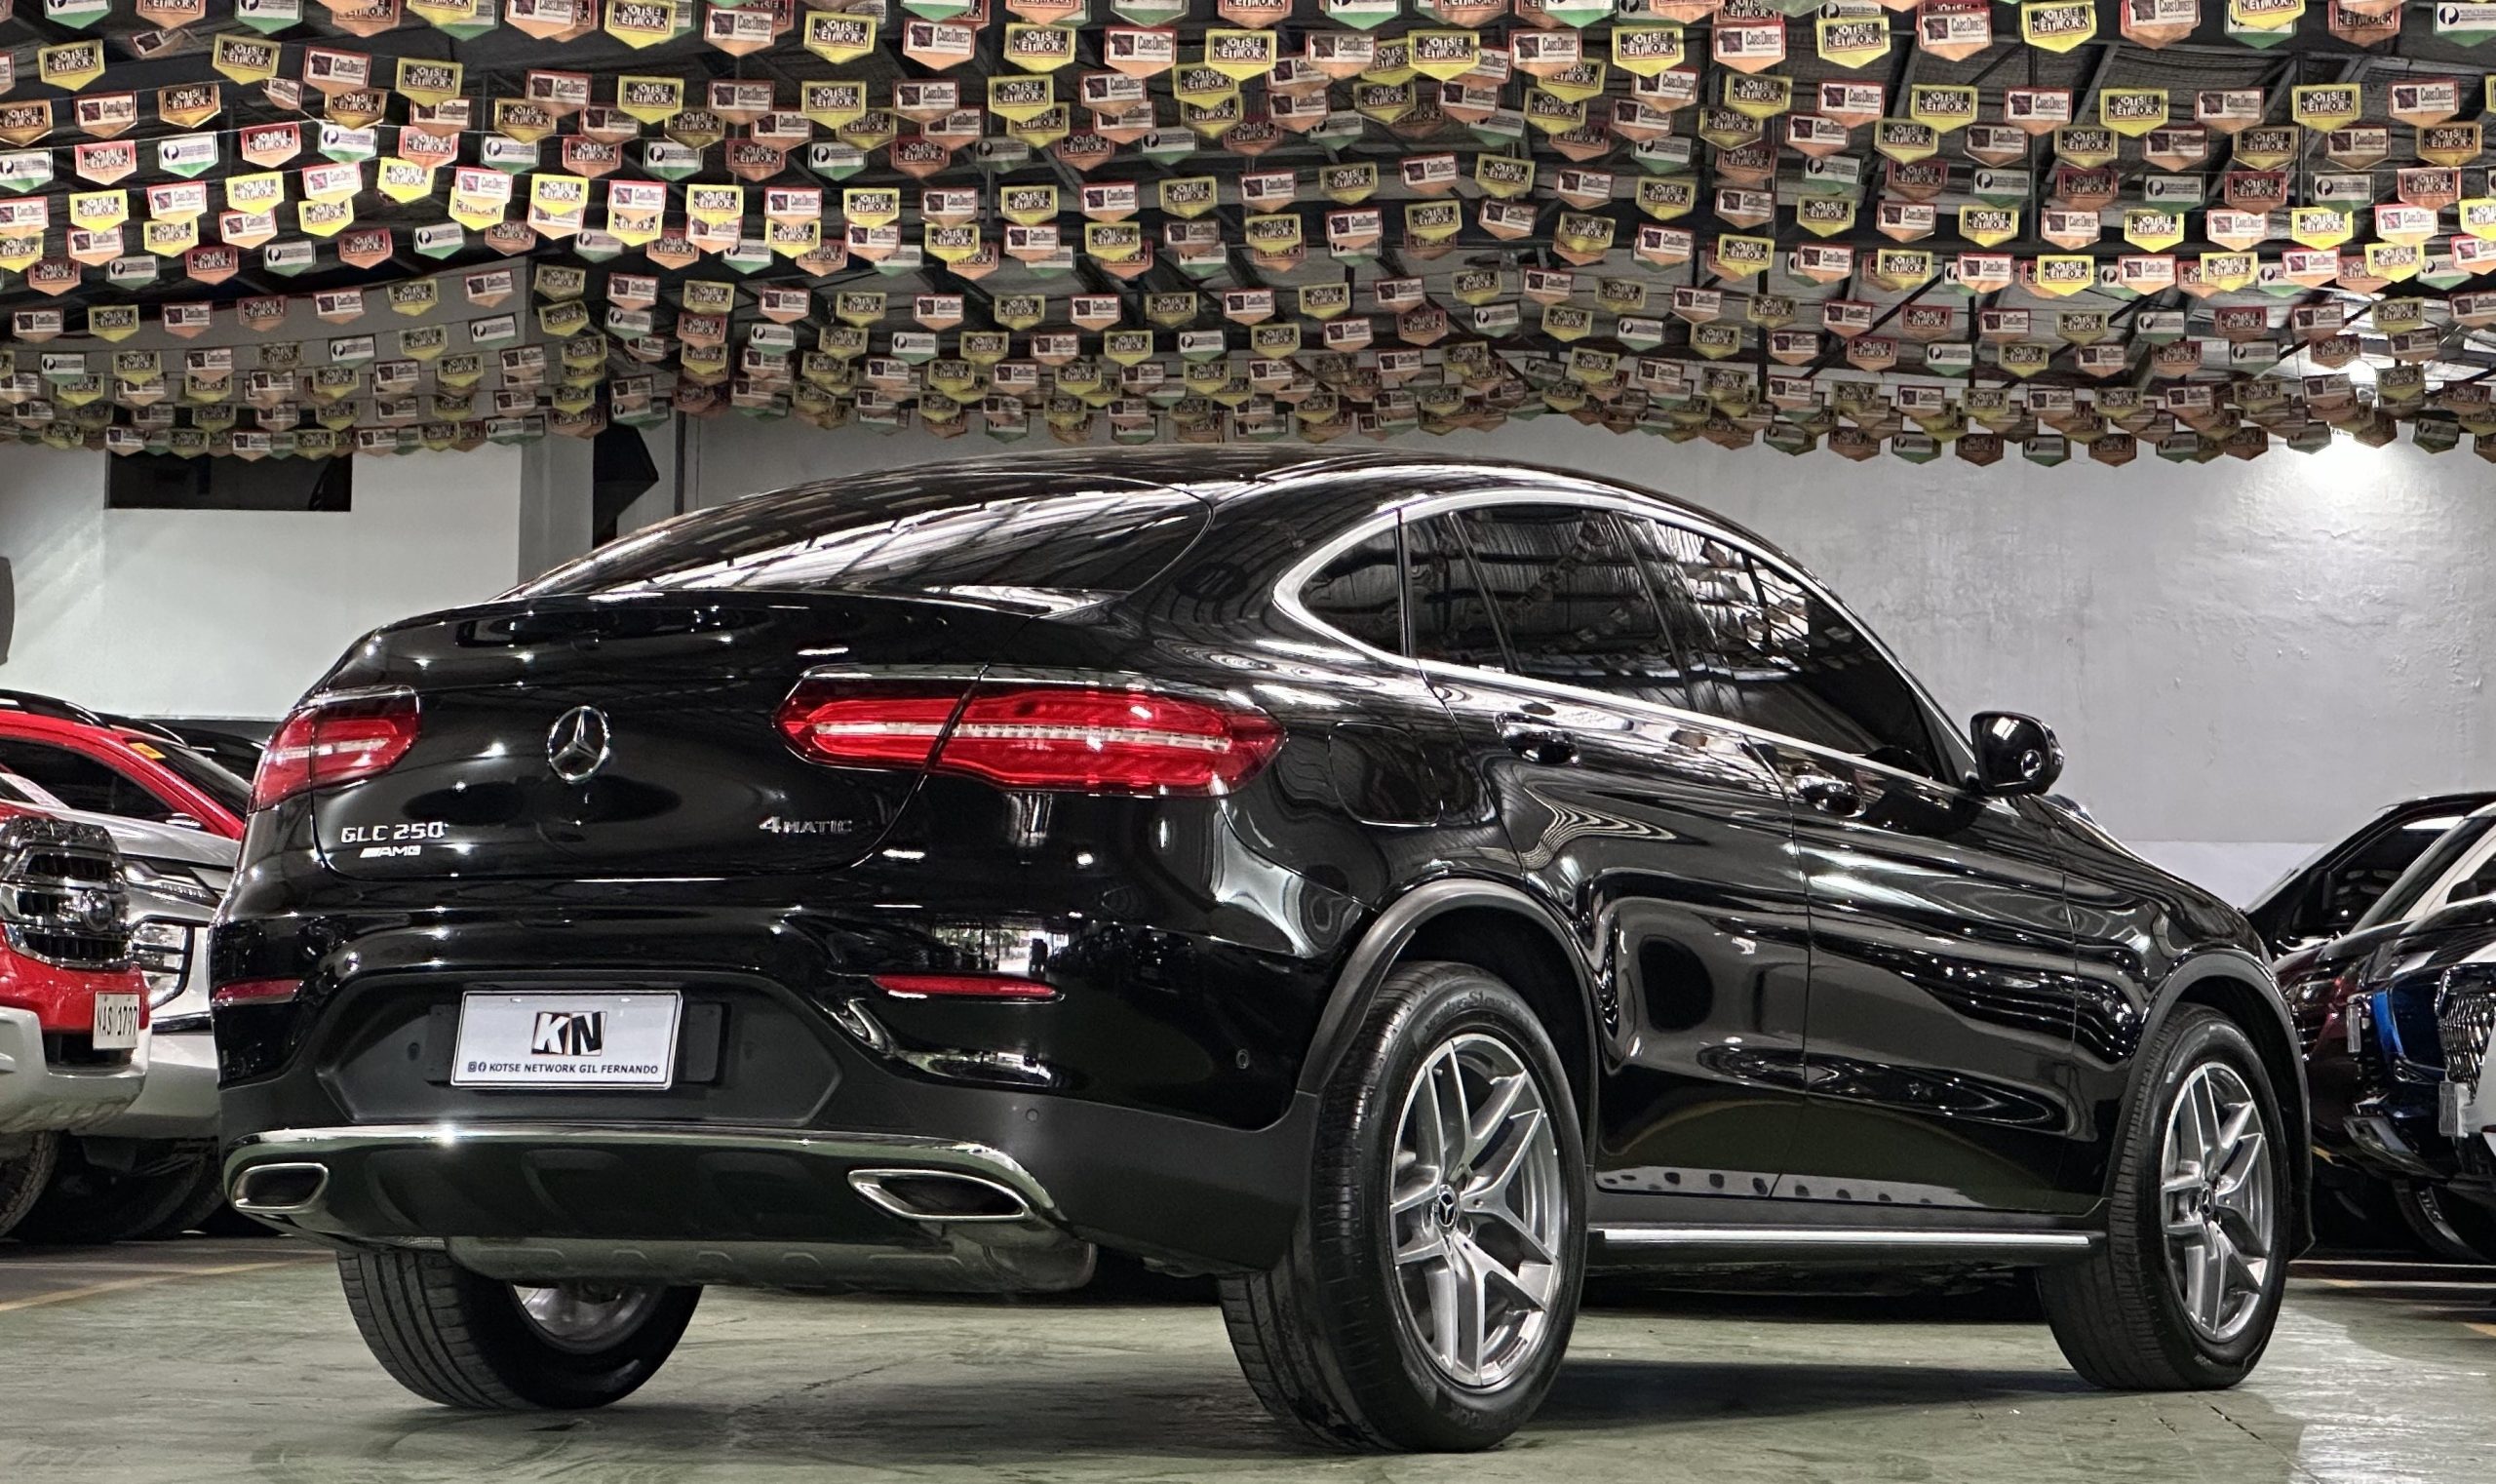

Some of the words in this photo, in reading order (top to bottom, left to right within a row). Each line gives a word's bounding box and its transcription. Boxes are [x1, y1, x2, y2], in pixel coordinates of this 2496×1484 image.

[623, 4, 660, 17] KOTSE
[2040, 7, 2079, 20] KOTSE
[613, 14, 667, 28] NETWORK
[823, 20, 860, 31] KOTSE
[2033, 17, 2087, 32] NETWORK
[1834, 23, 1872, 35] KOTSE
[813, 29, 866, 43] NETWORK
[1023, 30, 1060, 41] KOTSE
[1629, 33, 1666, 44] KOTSE
[1827, 34, 1881, 47] NETWORK
[1013, 41, 1067, 52] NETWORK
[1223, 37, 1260, 47] KOTSE
[1425, 38, 1462, 47] KOTSE
[55, 48, 88, 61] KOTSE
[230, 42, 264, 56] KOTSE
[1214, 48, 1268, 59] NETWORK
[1417, 48, 1470, 58] NETWORK
[1621, 43, 1675, 55] NETWORK
[48, 57, 97, 72] NETWORK
[221, 51, 270, 67] NETWORK
[412, 66, 447, 78] KOTSE
[405, 75, 453, 89] NETWORK
[1003, 82, 1037, 92] KOTSE
[1741, 79, 1776, 90] KOTSE
[173, 88, 205, 99] KOTSE
[634, 83, 668, 94] KOTSE
[817, 88, 851, 97] KOTSE
[1369, 86, 1401, 96] KOTSE
[1733, 88, 1783, 100] NETWORK
[626, 92, 675, 104] NETWORK
[996, 92, 1045, 102] NETWORK
[1362, 95, 1409, 104] NETWORK
[1928, 92, 1963, 101] KOTSE
[2117, 96, 2152, 105] KOTSE
[2309, 92, 2345, 101] KOTSE
[166, 96, 213, 110] NETWORK
[809, 98, 858, 107] NETWORK
[1919, 100, 1970, 112] NETWORK
[2301, 101, 2353, 112] NETWORK
[2109, 105, 2160, 116] NETWORK
[1891, 124, 1924, 135] KOTSE
[2432, 129, 2467, 138] KOTSE
[254, 131, 286, 142] KOTSE
[1883, 133, 1930, 144] NETWORK
[250, 138, 293, 152] NETWORK
[2062, 140, 2110, 150] NETWORK
[2242, 141, 2290, 150] NETWORK
[2424, 137, 2474, 148] NETWORK
[1902, 166, 1934, 175] KOTSE
[1894, 174, 1940, 184] NETWORK
[2414, 174, 2446, 183] KOTSE
[2233, 187, 2280, 196] NETWORK
[2406, 182, 2454, 193] NETWORK
[759, 816, 853, 835] 4MATIC
[340, 825, 388, 842] GLC
[393, 822, 447, 841] 250
[378, 845, 421, 856] AMG
[532, 1011, 604, 1055] KN
[489, 1063, 521, 1074] KOTSE
[524, 1064, 575, 1074] NETWORK
[579, 1065, 598, 1074] GIL
[601, 1065, 658, 1074] FERNANDO
